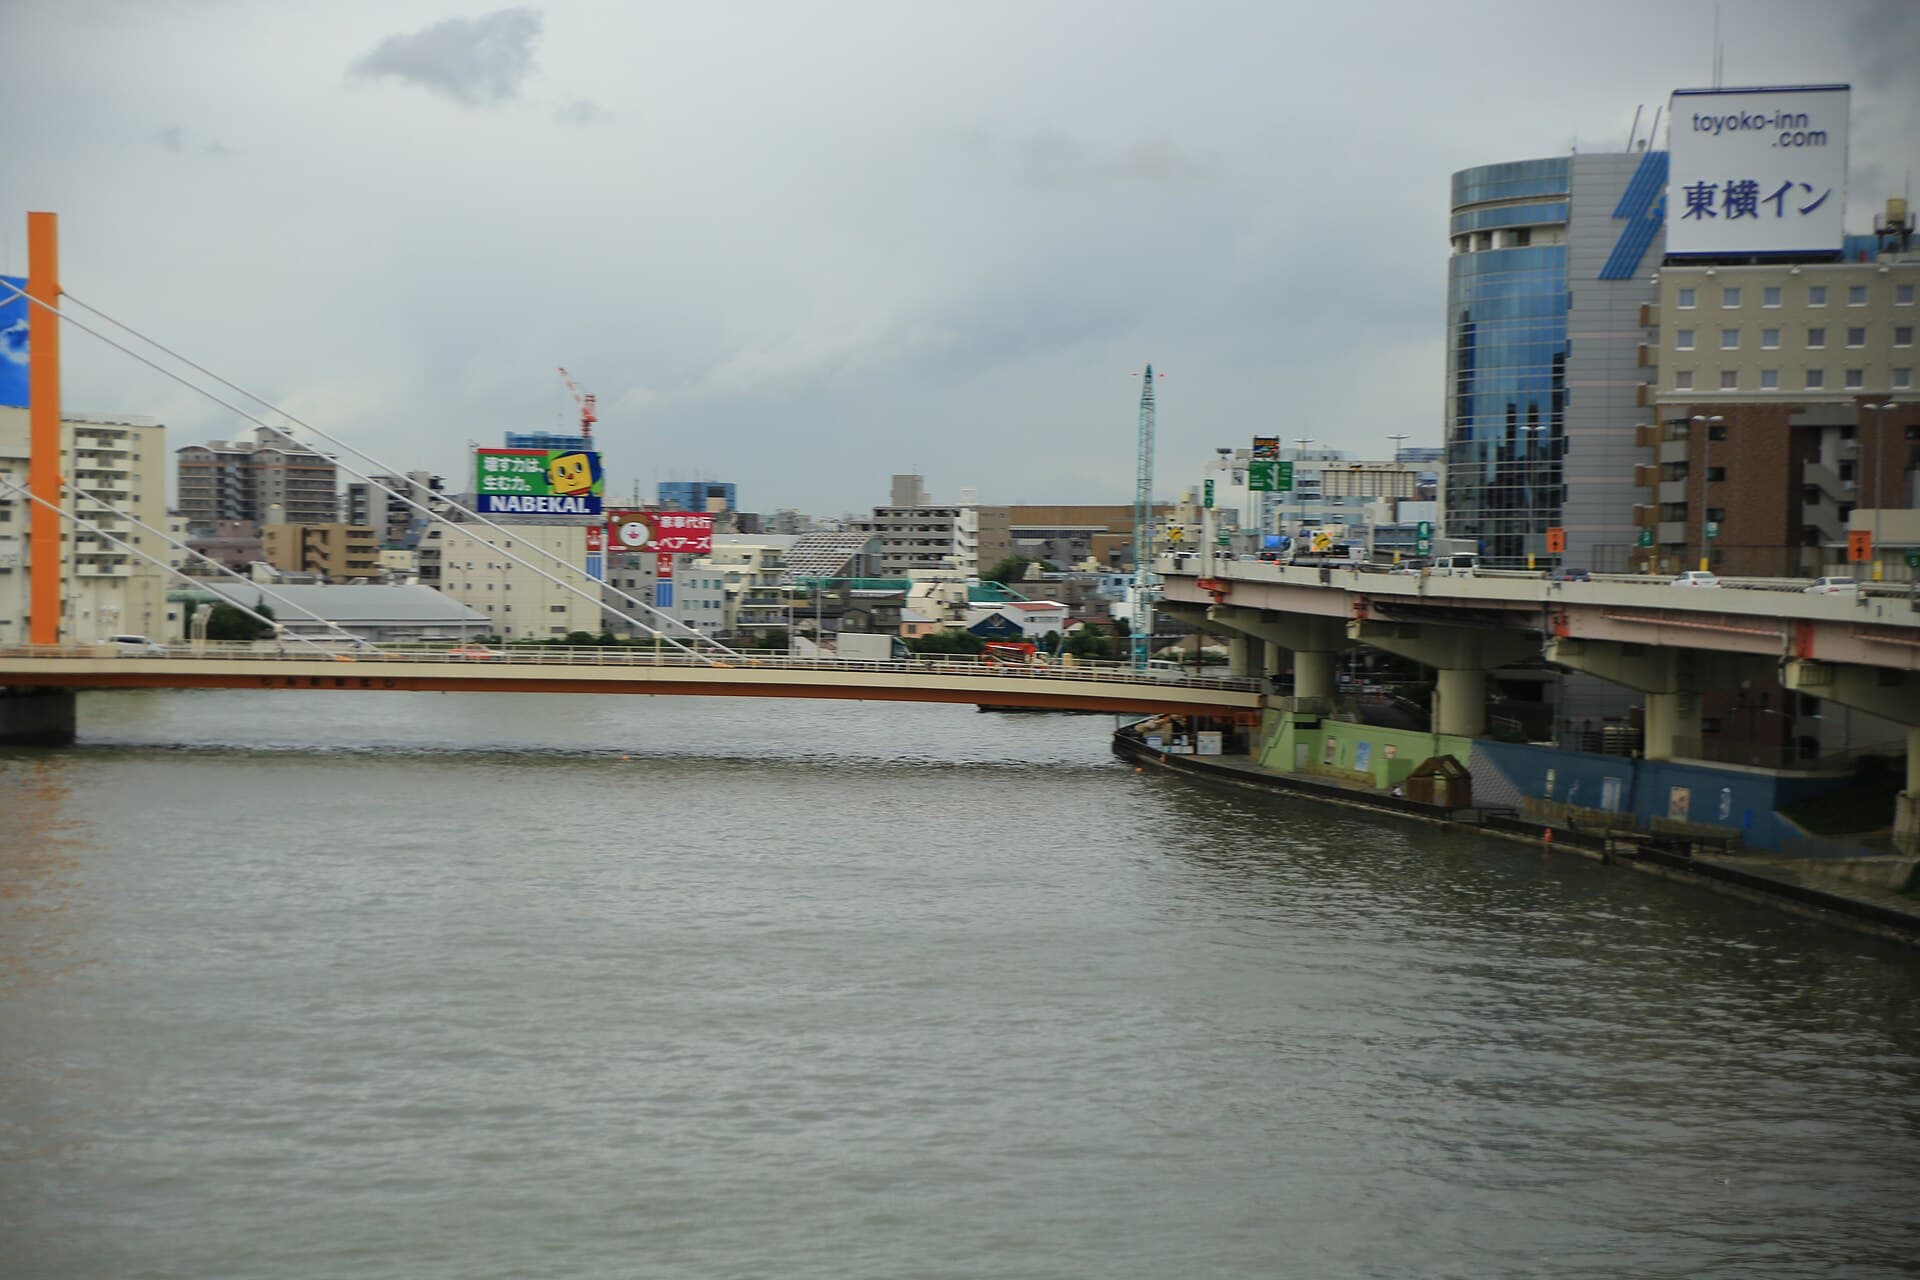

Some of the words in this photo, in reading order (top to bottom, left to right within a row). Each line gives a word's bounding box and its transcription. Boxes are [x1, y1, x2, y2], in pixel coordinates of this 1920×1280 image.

[1692, 110, 1809, 137] toyoko-inn
[1771, 130, 1828, 148] .com
[1680, 180, 1832, 221] 東横イン
